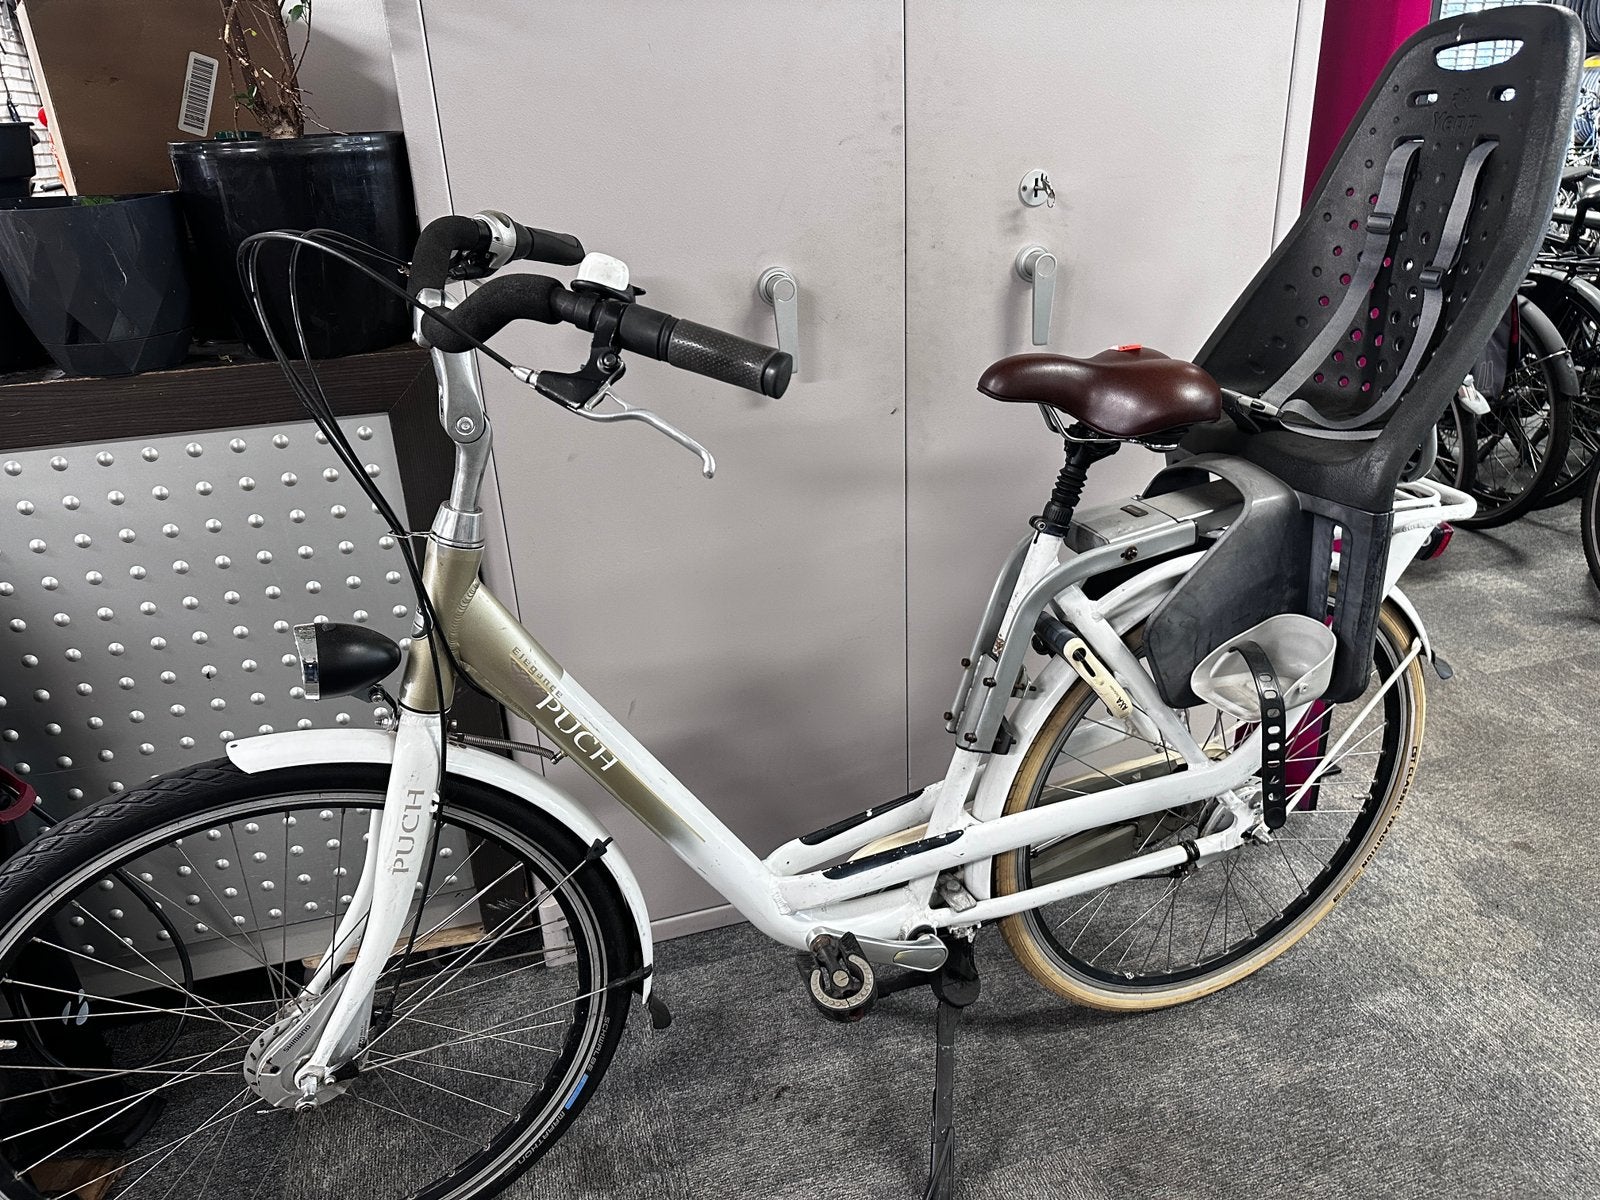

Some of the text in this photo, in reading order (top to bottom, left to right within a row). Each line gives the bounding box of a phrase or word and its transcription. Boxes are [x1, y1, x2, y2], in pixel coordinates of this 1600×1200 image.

[512, 646, 563, 698] Elegance
[1116, 696, 1128, 710] AXA
[535, 694, 619, 772] PUCH
[1395, 767, 1413, 811] CLASSIC
[392, 789, 425, 875] PUCH
[1362, 815, 1396, 868] TRADITION
[283, 1024, 311, 1053] SHIMANO
[587, 1016, 611, 1072] SCHWALBE
[517, 1111, 566, 1165] MARATHON
